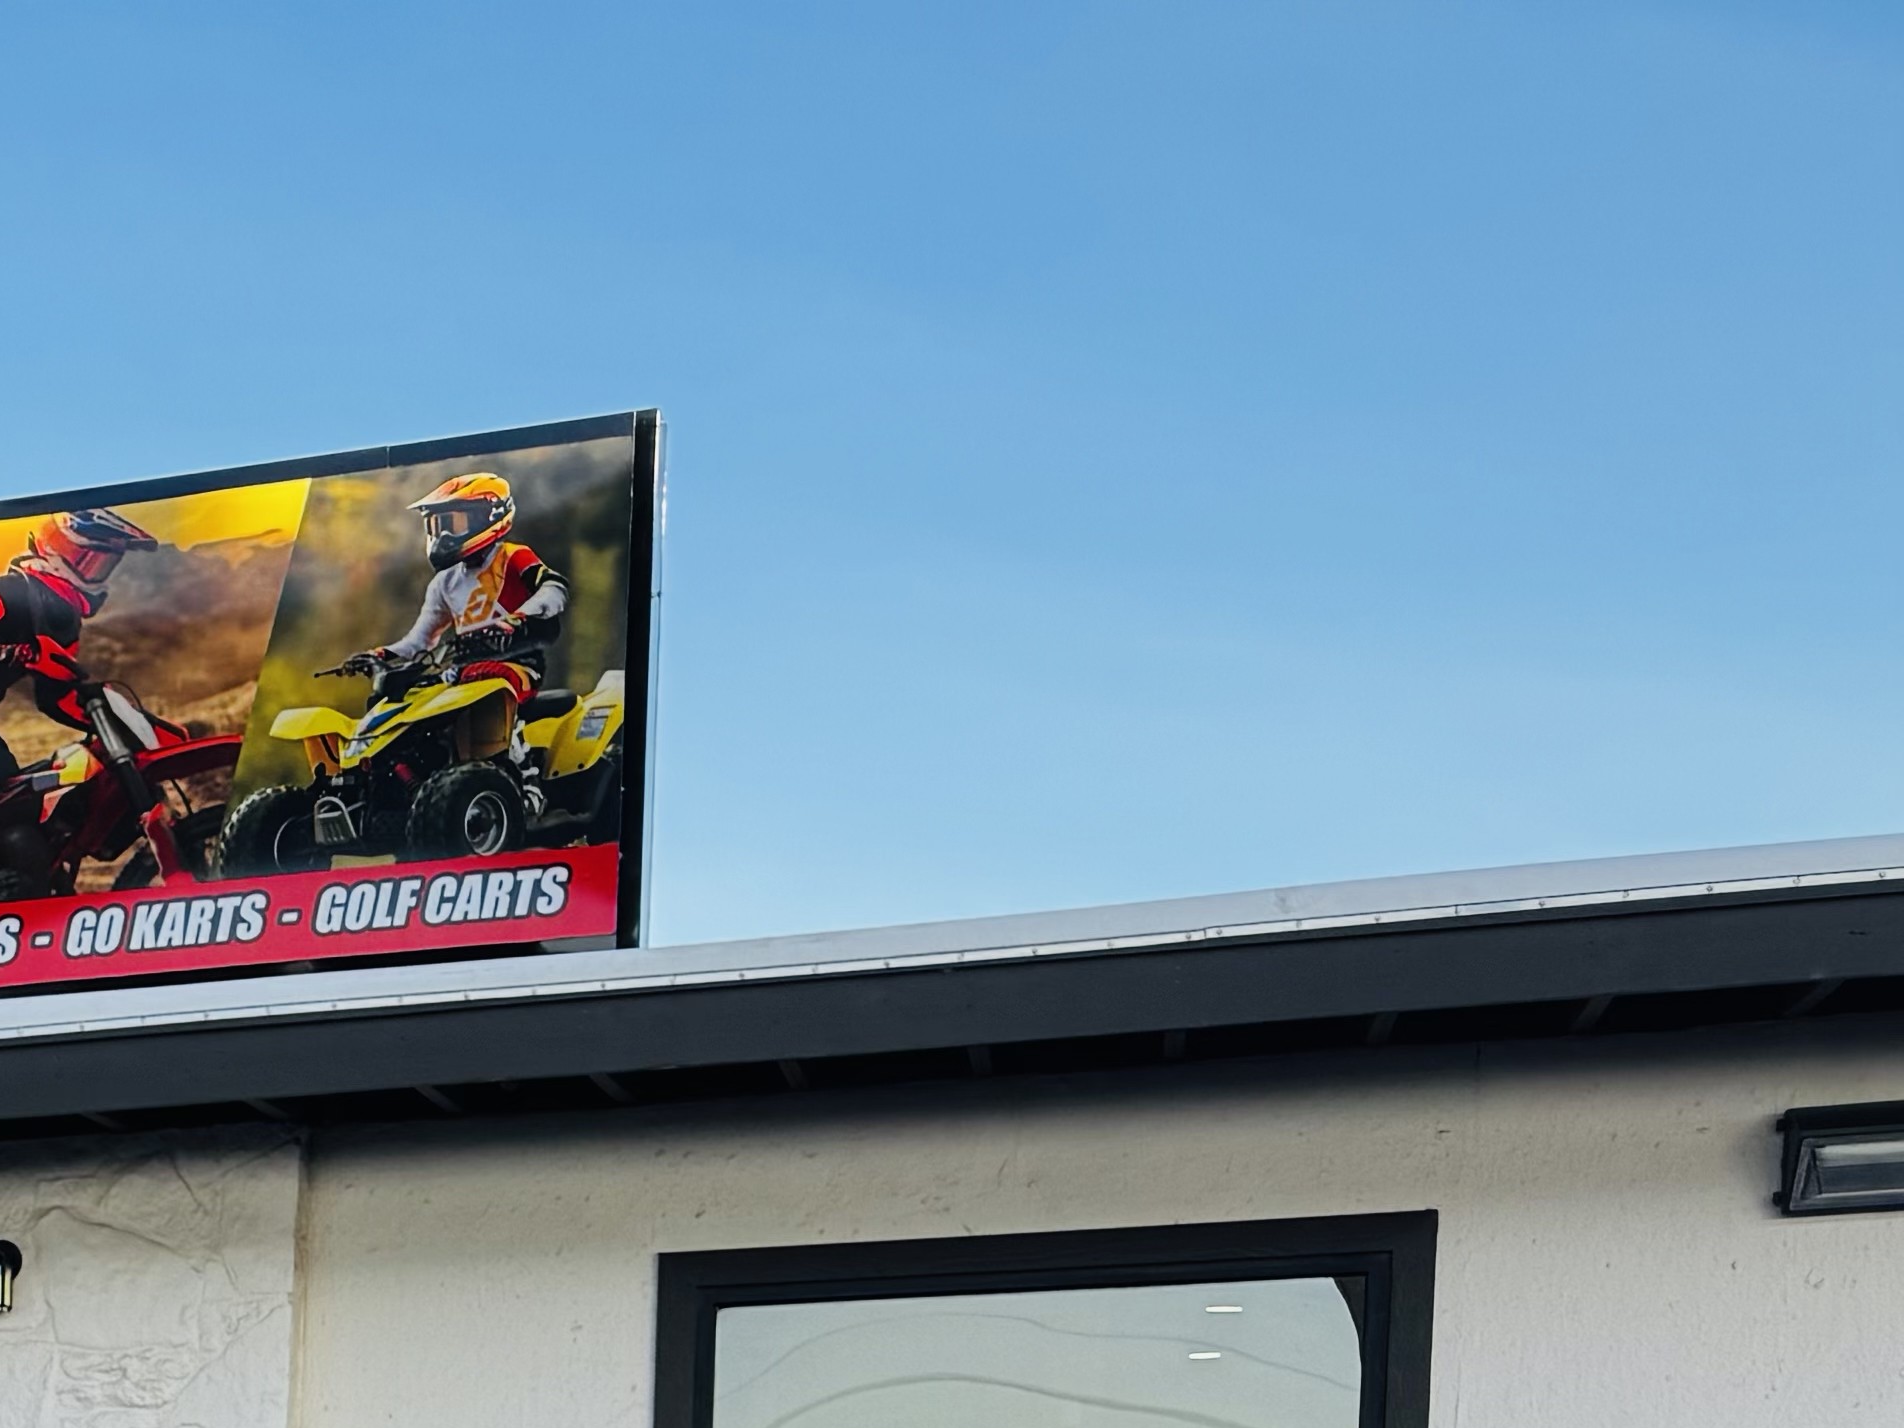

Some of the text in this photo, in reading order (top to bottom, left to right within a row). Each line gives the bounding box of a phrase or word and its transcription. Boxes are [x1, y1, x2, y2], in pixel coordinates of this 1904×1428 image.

[65, 907, 126, 957] GO
[128, 892, 266, 952] KARTS
[314, 876, 423, 935] GOLF
[426, 866, 572, 925] CARTS
